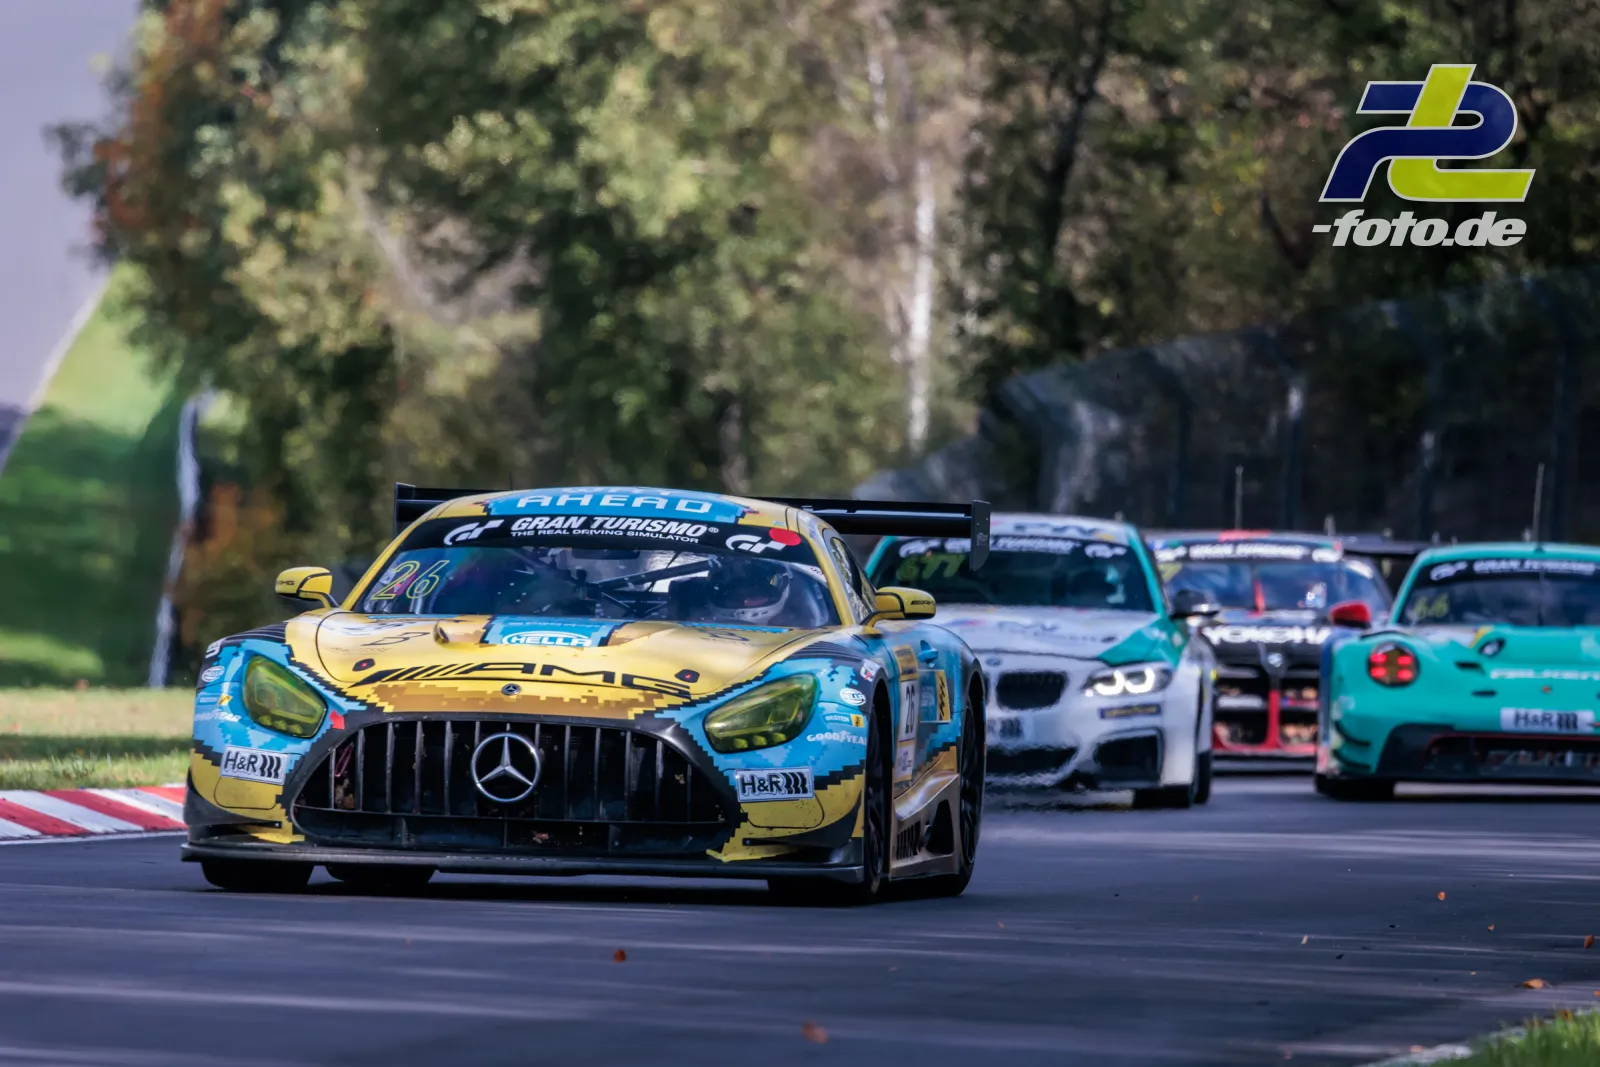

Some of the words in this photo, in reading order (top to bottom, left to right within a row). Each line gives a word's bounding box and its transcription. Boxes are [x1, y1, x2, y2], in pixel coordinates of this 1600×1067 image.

[516, 494, 713, 514] AHEAD
[511, 516, 585, 531] GRAN
[626, 530, 700, 544] SIMULATOR
[369, 559, 450, 600] 26
[510, 635, 592, 647] HELLA
[454, 662, 691, 700] AMG
[904, 683, 916, 735] 26
[223, 755, 258, 774] H&R
[739, 774, 784, 796] H&R
